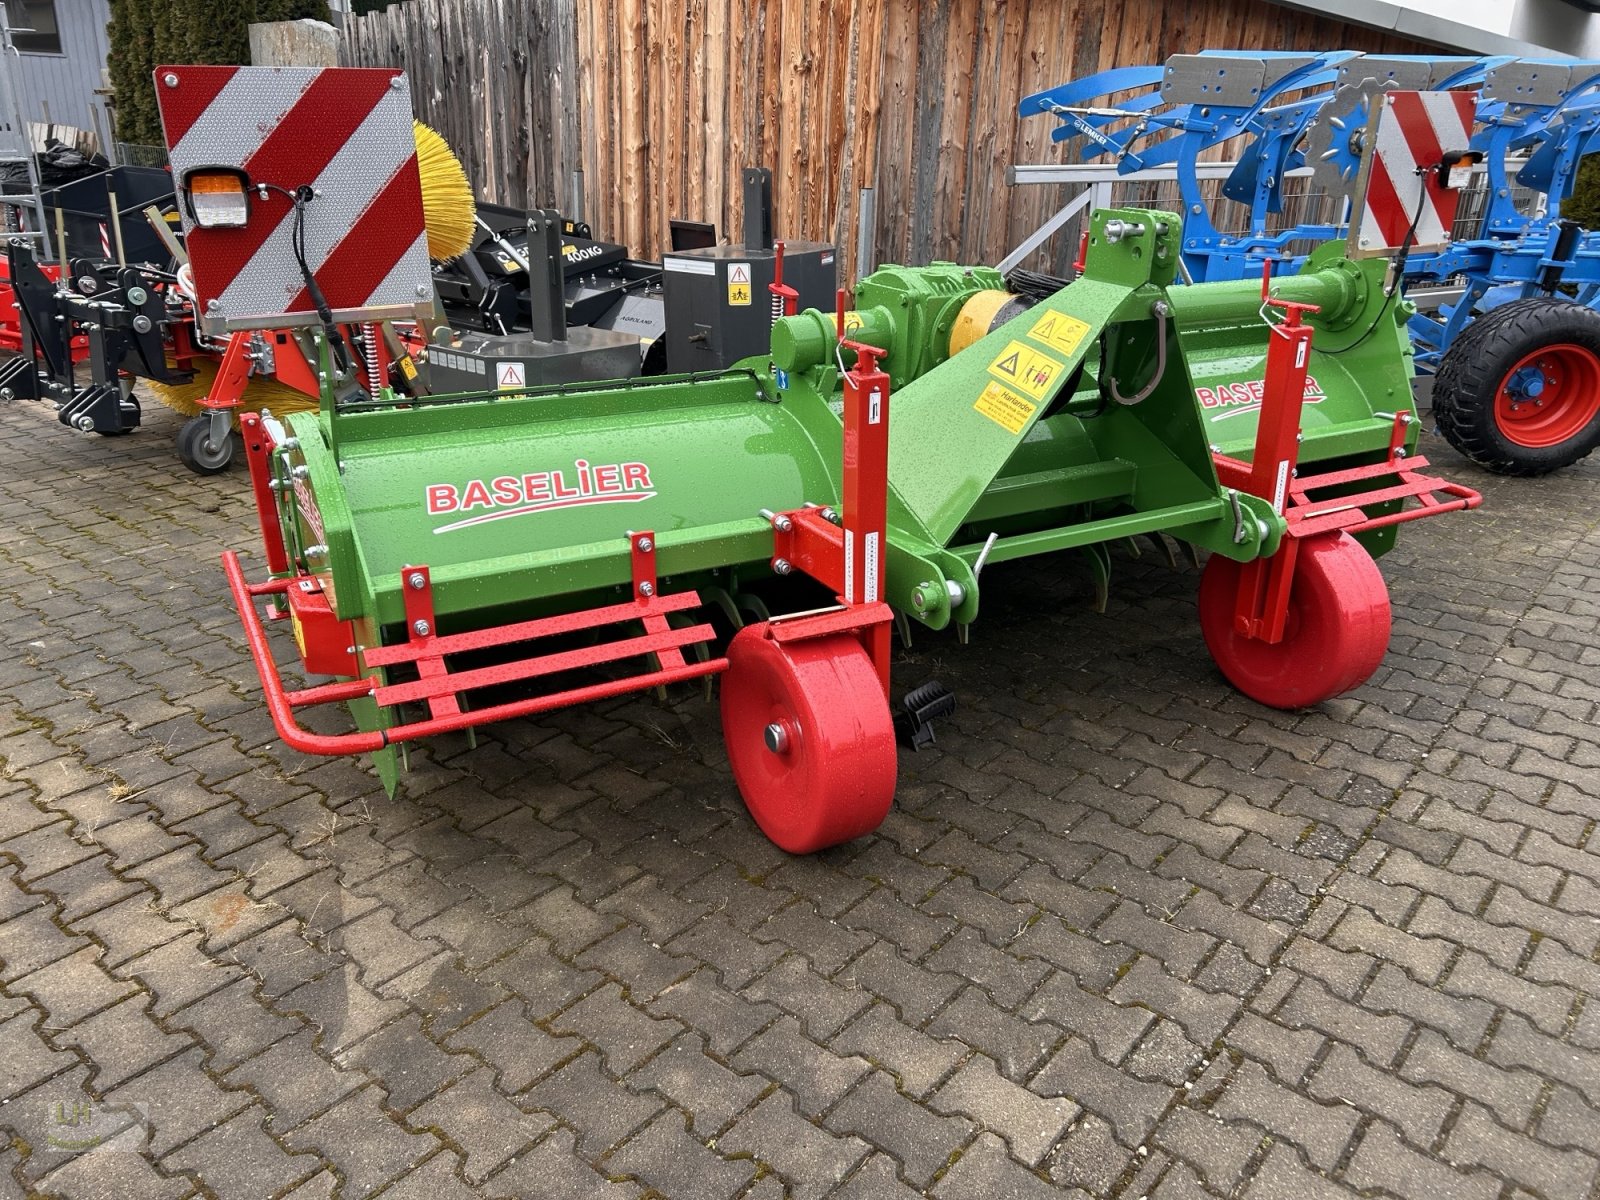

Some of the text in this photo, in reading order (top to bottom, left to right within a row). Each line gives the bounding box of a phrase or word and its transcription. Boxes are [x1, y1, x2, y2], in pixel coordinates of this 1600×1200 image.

[567, 245, 603, 263] 400KG
[1000, 391, 1033, 414] Harlander
[1195, 374, 1324, 409] BASER
